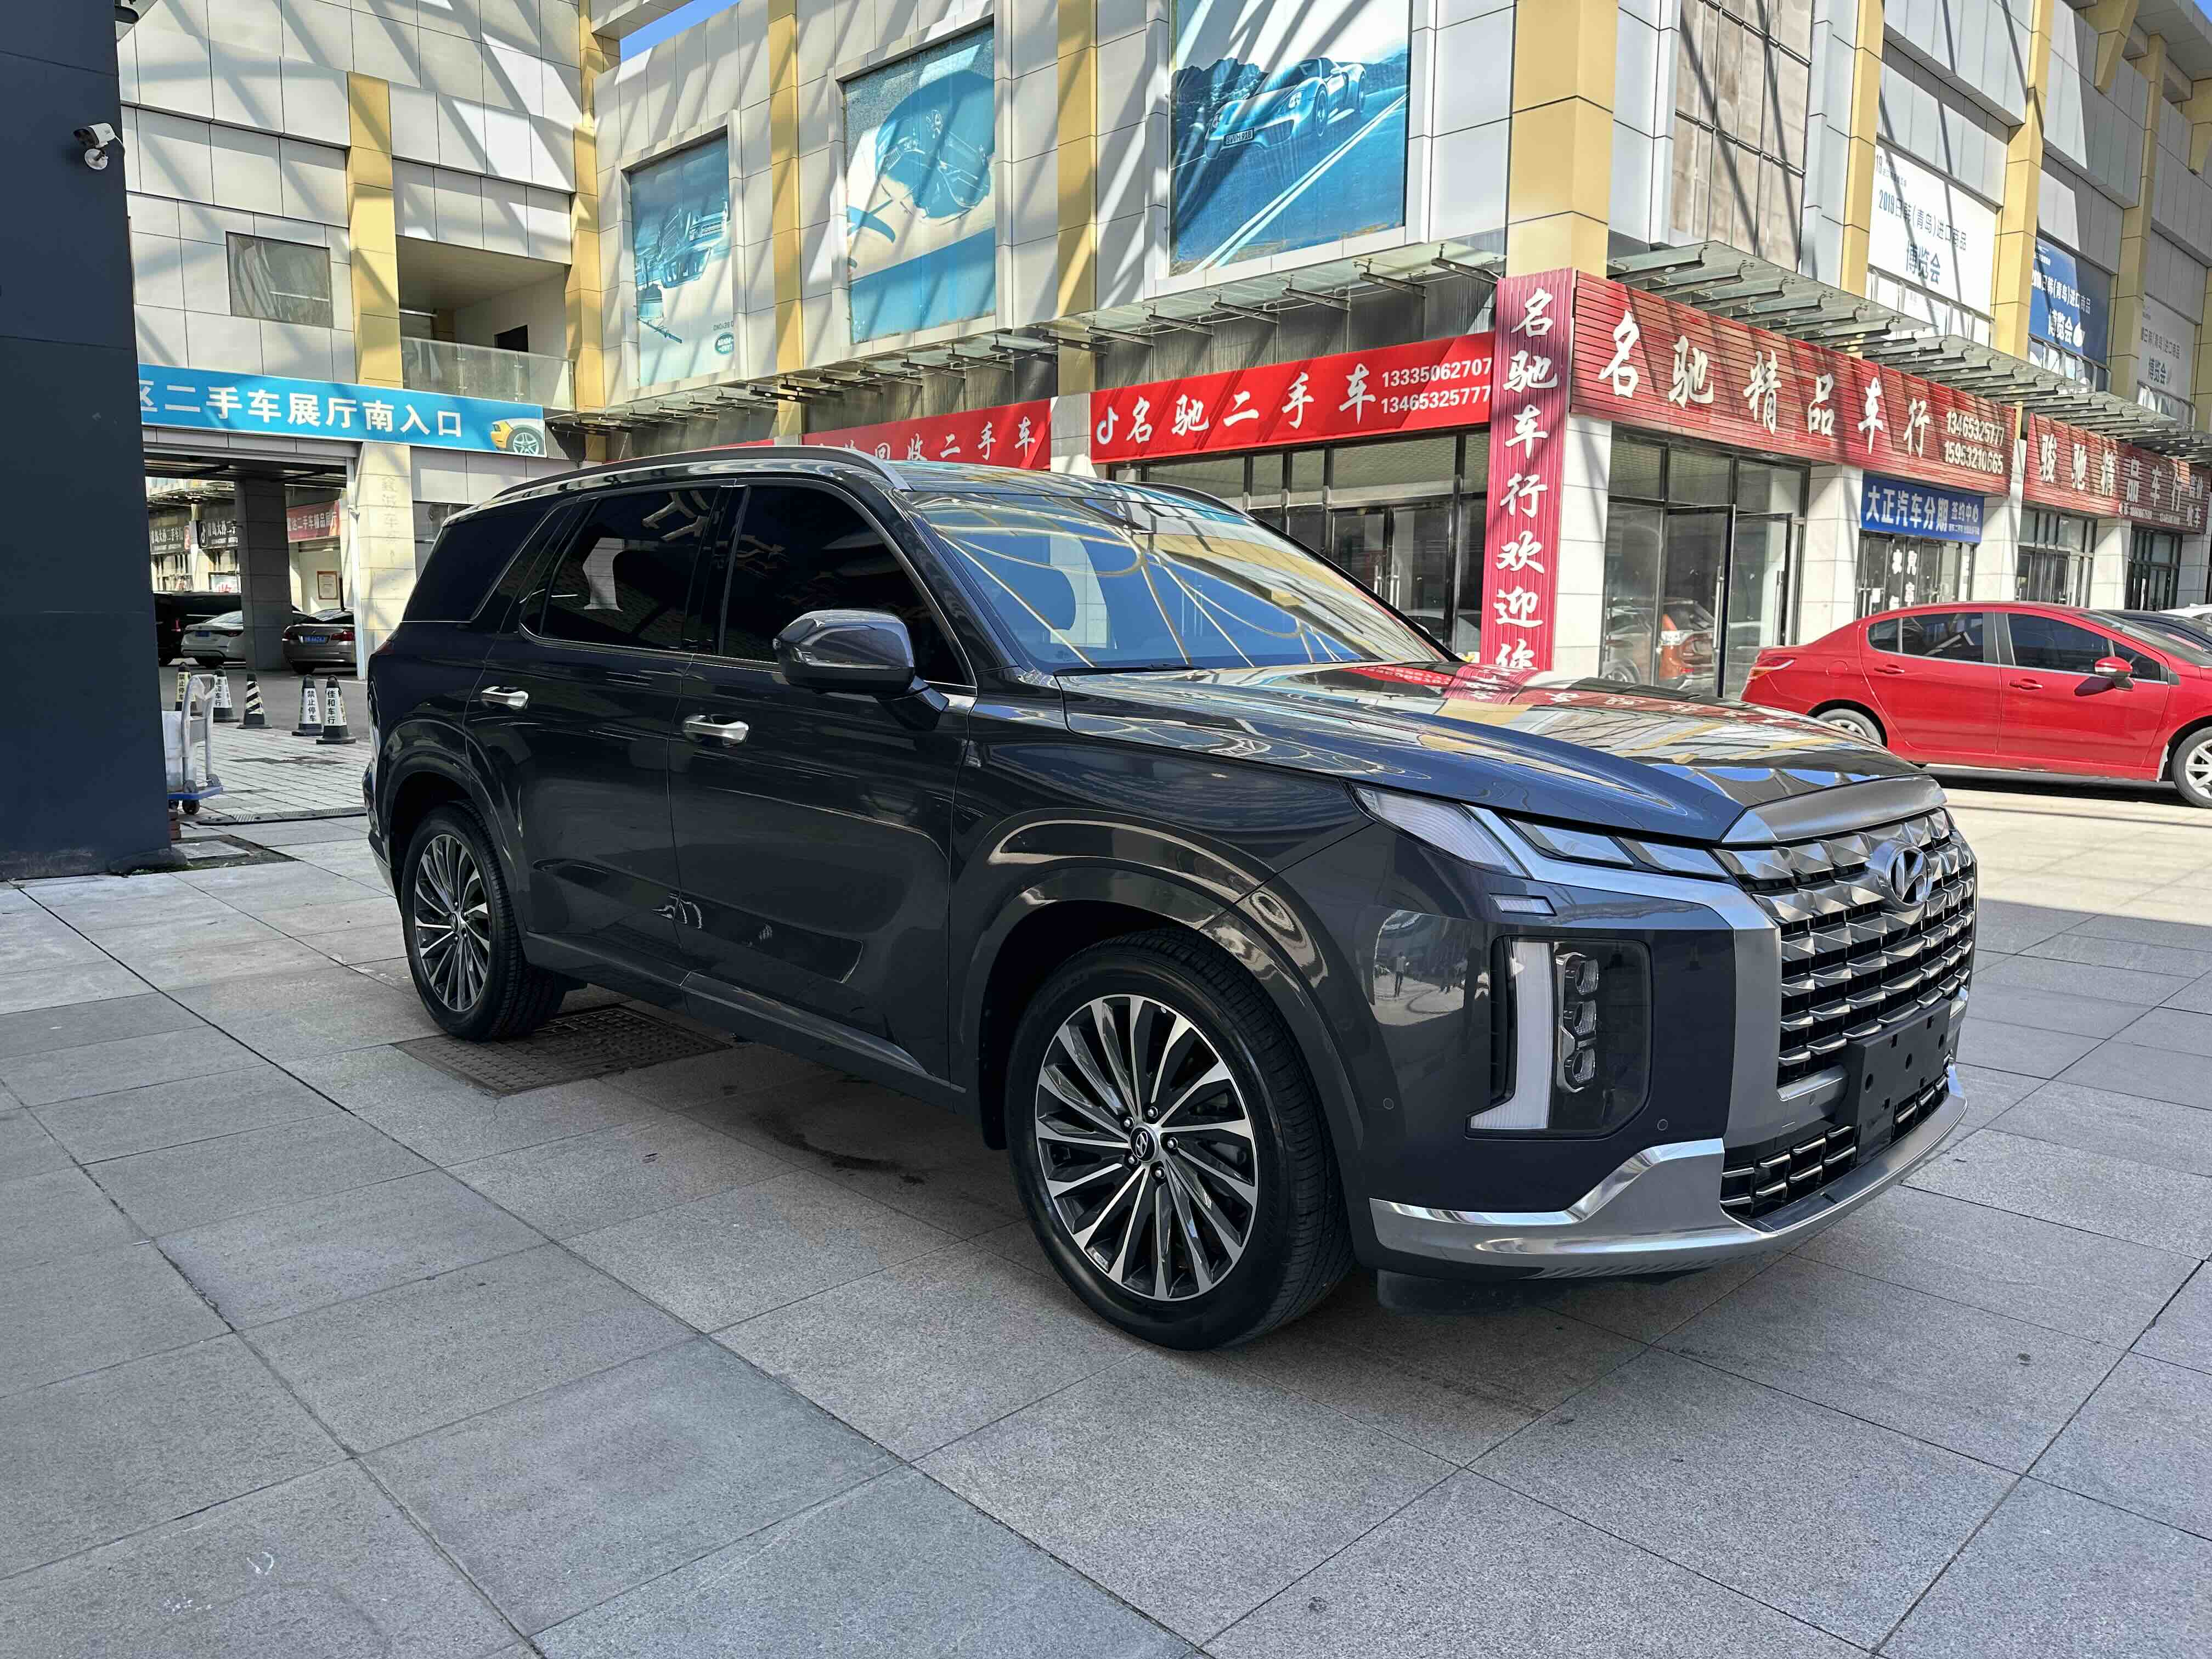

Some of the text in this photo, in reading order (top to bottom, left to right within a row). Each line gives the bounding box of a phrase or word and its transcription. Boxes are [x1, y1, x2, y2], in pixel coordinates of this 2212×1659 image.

[1241, 130, 1251, 140] 918
[1906, 240, 1940, 285] 博览会
[2047, 307, 2073, 345] 博览会
[1381, 357, 1492, 388] 13335062707
[1598, 309, 1931, 458] 名驰精品车行
[1126, 363, 1376, 444] 名驰二手车
[1380, 385, 1491, 415] 13465325777
[1946, 411, 2005, 447] 13465325777
[1944, 441, 2004, 475] 15953210665
[1865, 485, 1949, 532] 大正汽车分期
[307, 691, 316, 722] 禁止停车
[328, 690, 336, 724] 佳和车行
